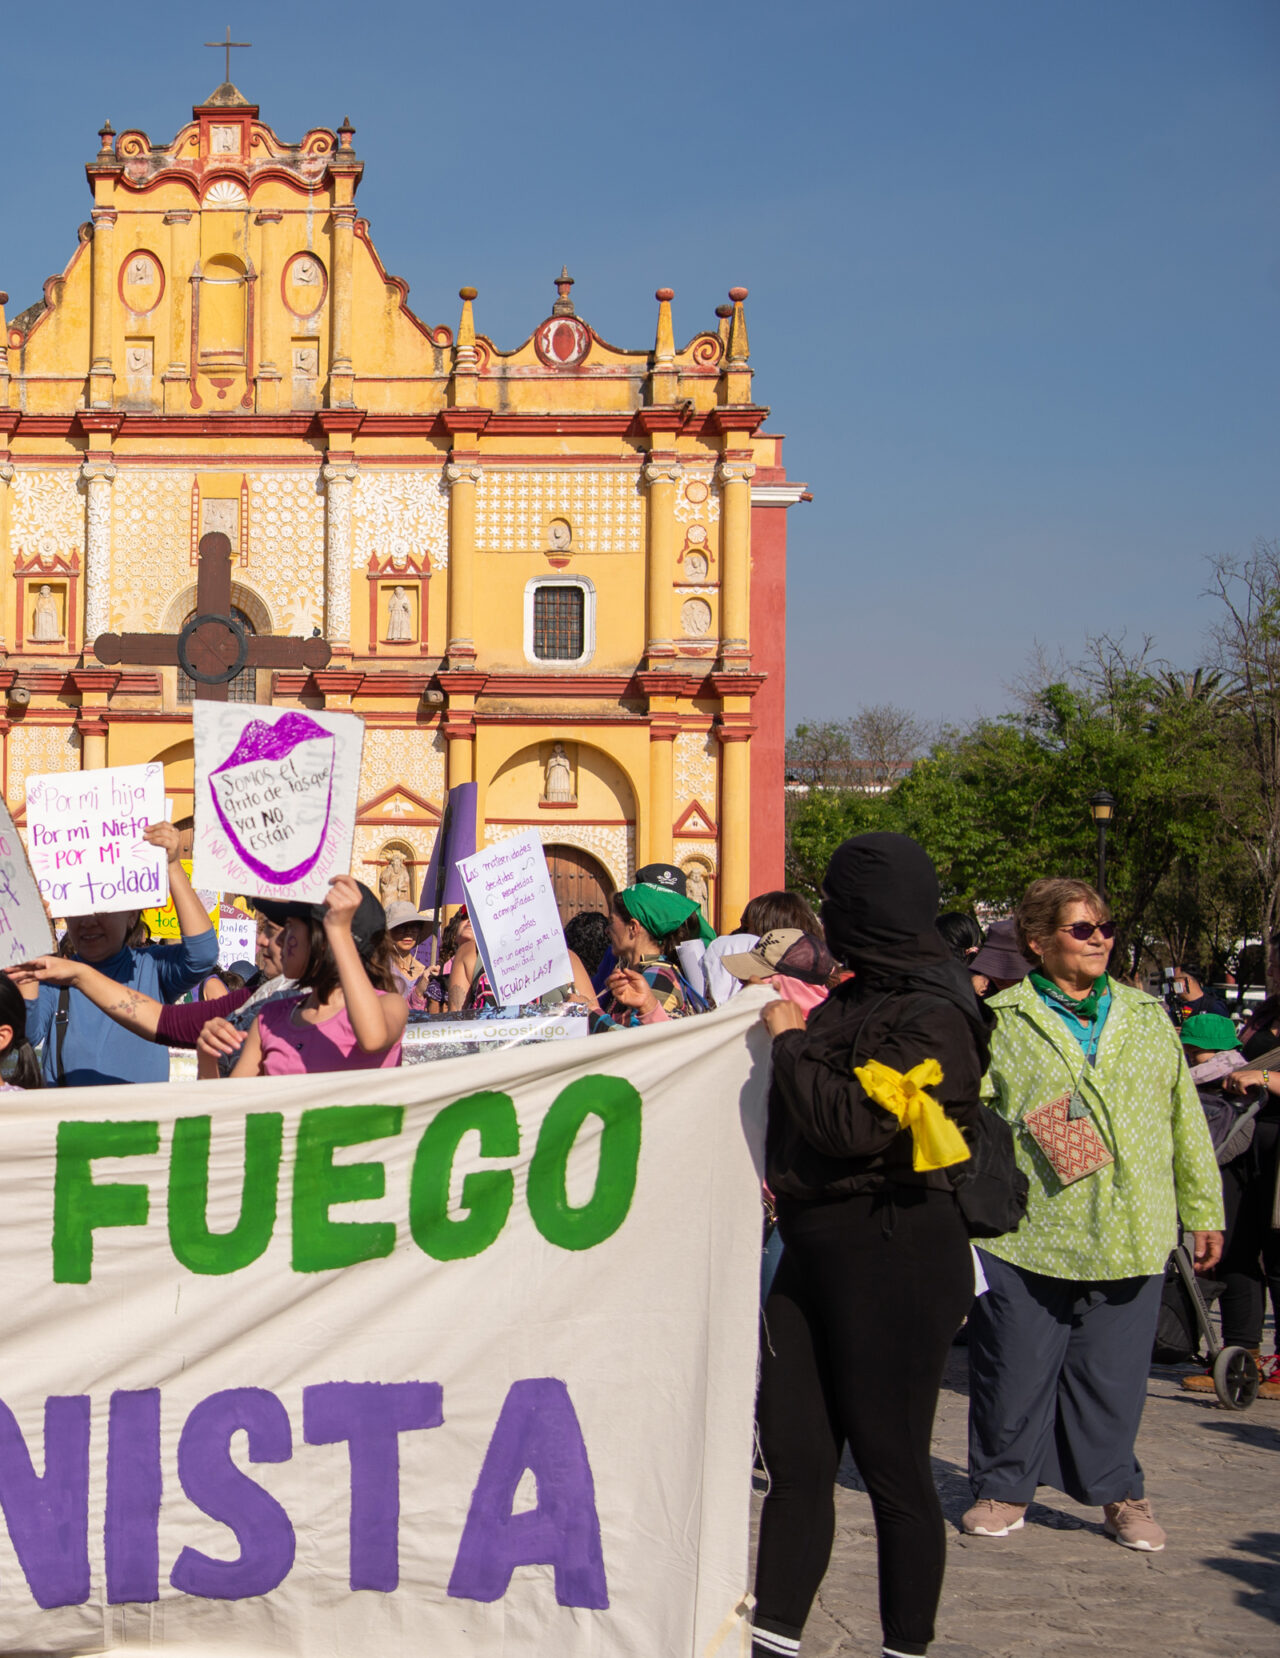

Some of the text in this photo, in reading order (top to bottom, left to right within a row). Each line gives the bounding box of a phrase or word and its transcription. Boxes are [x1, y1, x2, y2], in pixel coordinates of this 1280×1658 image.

[280, 758, 299, 782] el
[45, 776, 145, 817] Por mi hija
[224, 767, 330, 818] grito de las que
[33, 816, 149, 846] Por mi Nieta
[235, 807, 284, 835] ya NO
[99, 842, 120, 864] Mi
[208, 839, 227, 860] NO
[222, 859, 250, 885] NOS
[255, 878, 297, 898] VAMOS
[301, 880, 312, 895] A
[462, 864, 480, 883] Las
[406, 1026, 478, 1040] alestina,
[52, 1073, 643, 1285] FUEGO
